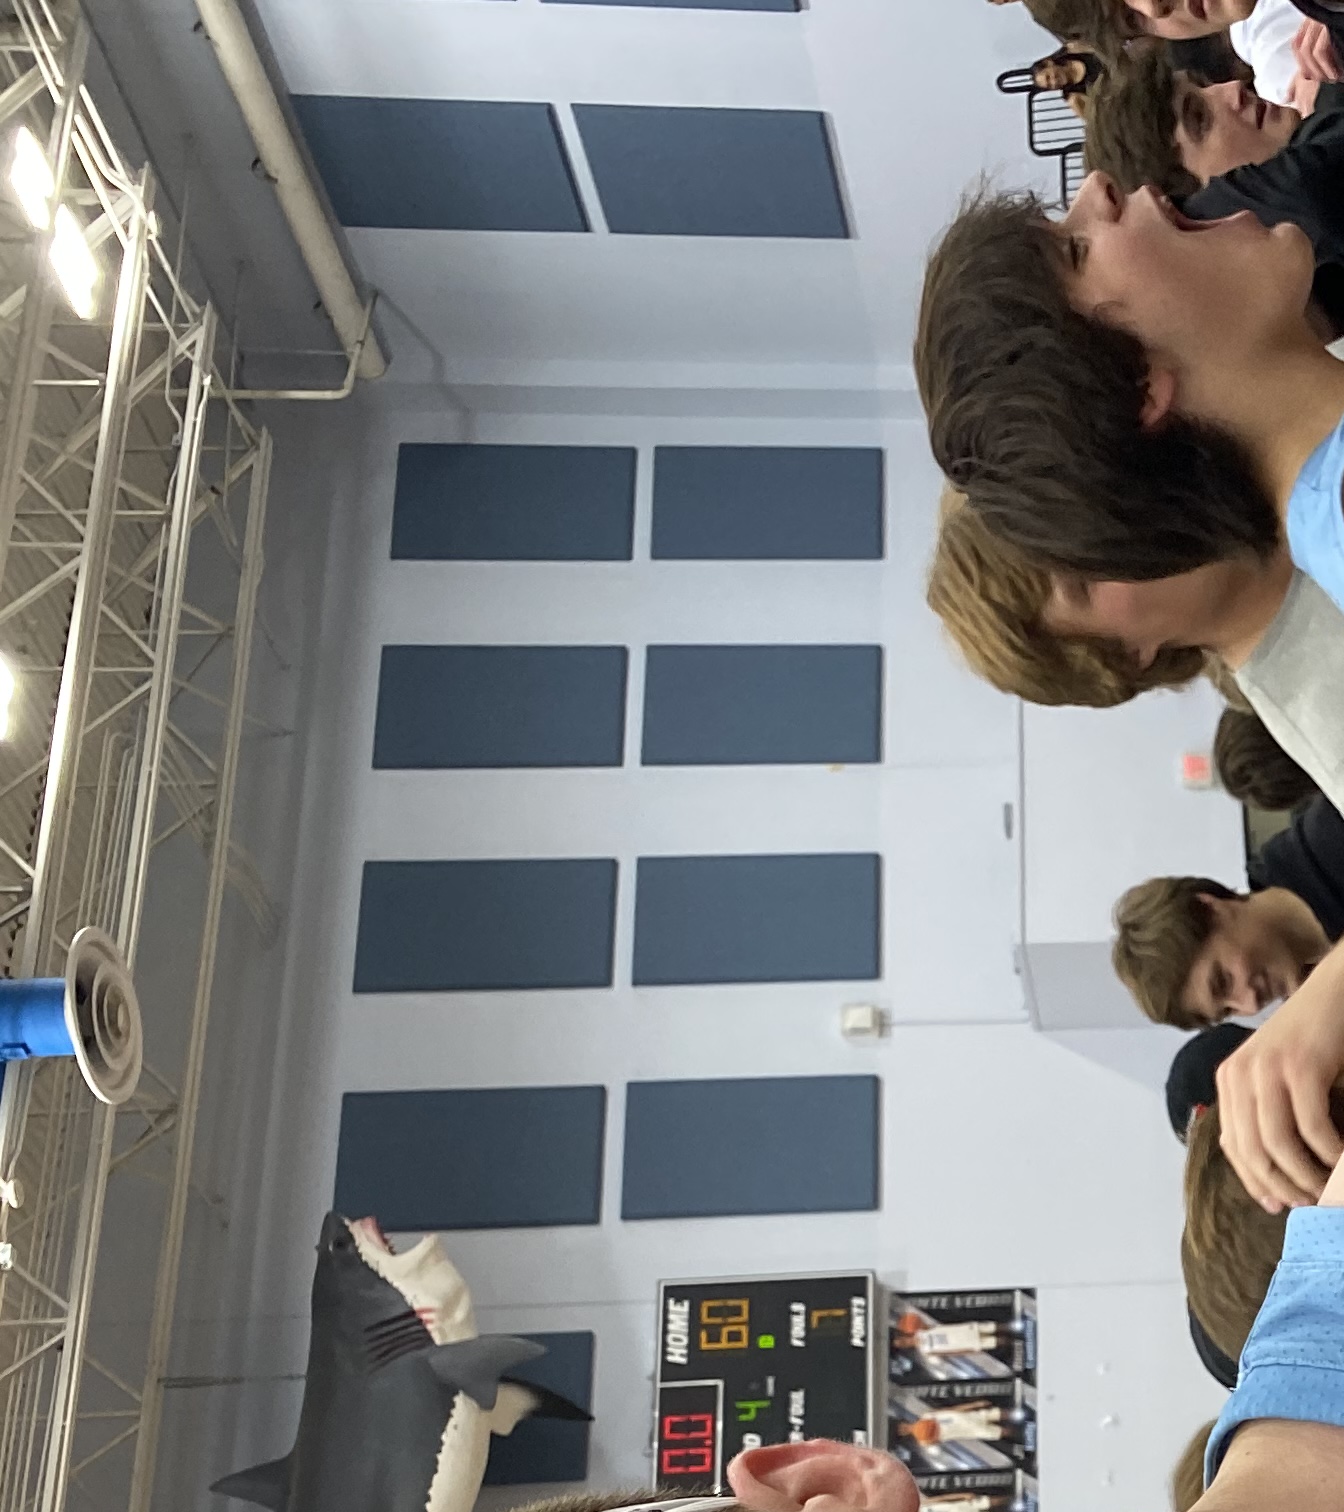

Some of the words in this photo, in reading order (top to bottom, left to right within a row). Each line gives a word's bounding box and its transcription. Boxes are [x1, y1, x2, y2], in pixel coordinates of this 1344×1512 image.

[666, 1297, 690, 1364] HOME
[699, 1299, 749, 1350] 60
[811, 1308, 848, 1329] 7
[735, 1400, 771, 1421] 4
[661, 1414, 713, 1474] 0.0
